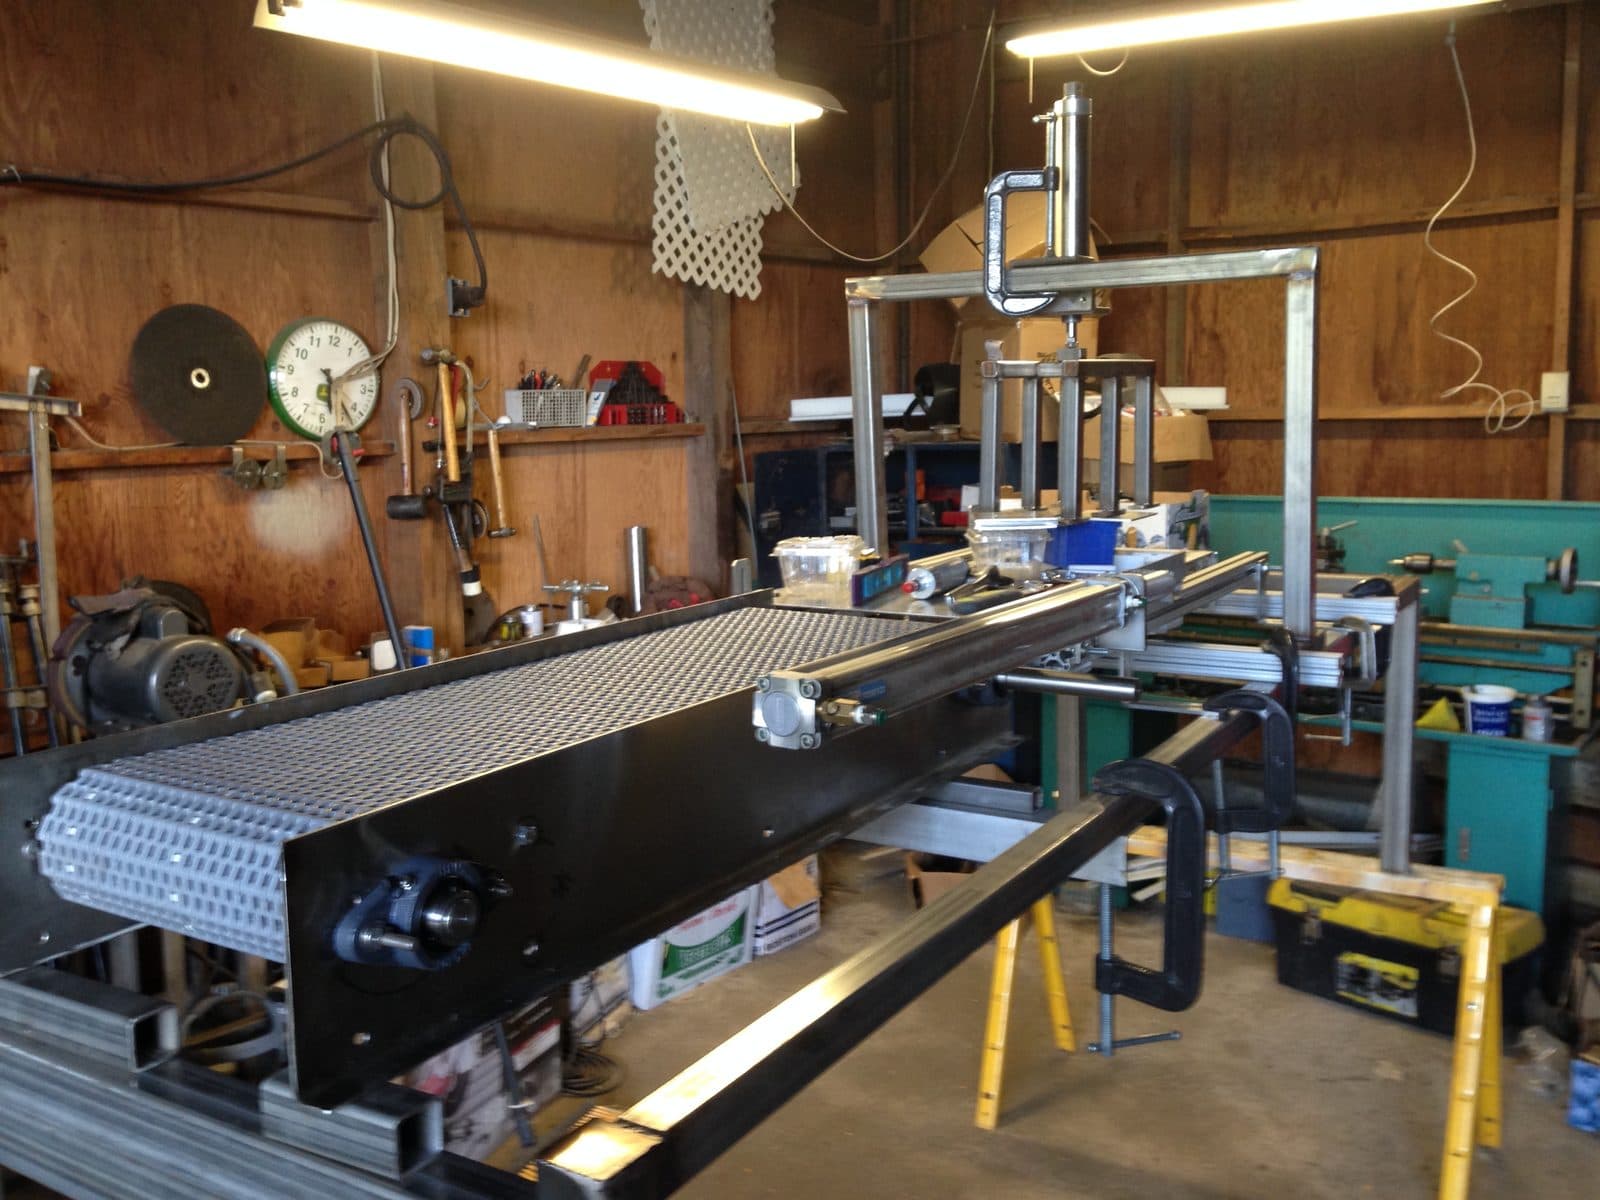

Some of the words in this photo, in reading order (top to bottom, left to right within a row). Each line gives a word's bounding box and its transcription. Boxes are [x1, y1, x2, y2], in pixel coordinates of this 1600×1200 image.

[310, 336, 320, 348] 11
[328, 336, 340, 347] 12
[296, 348, 308, 360] 10
[287, 364, 294, 374] 9
[291, 387, 298, 397] 8
[360, 384, 367, 394] 3
[304, 403, 310, 413] 7
[351, 402, 358, 412] 4
[320, 413, 326, 424] 6
